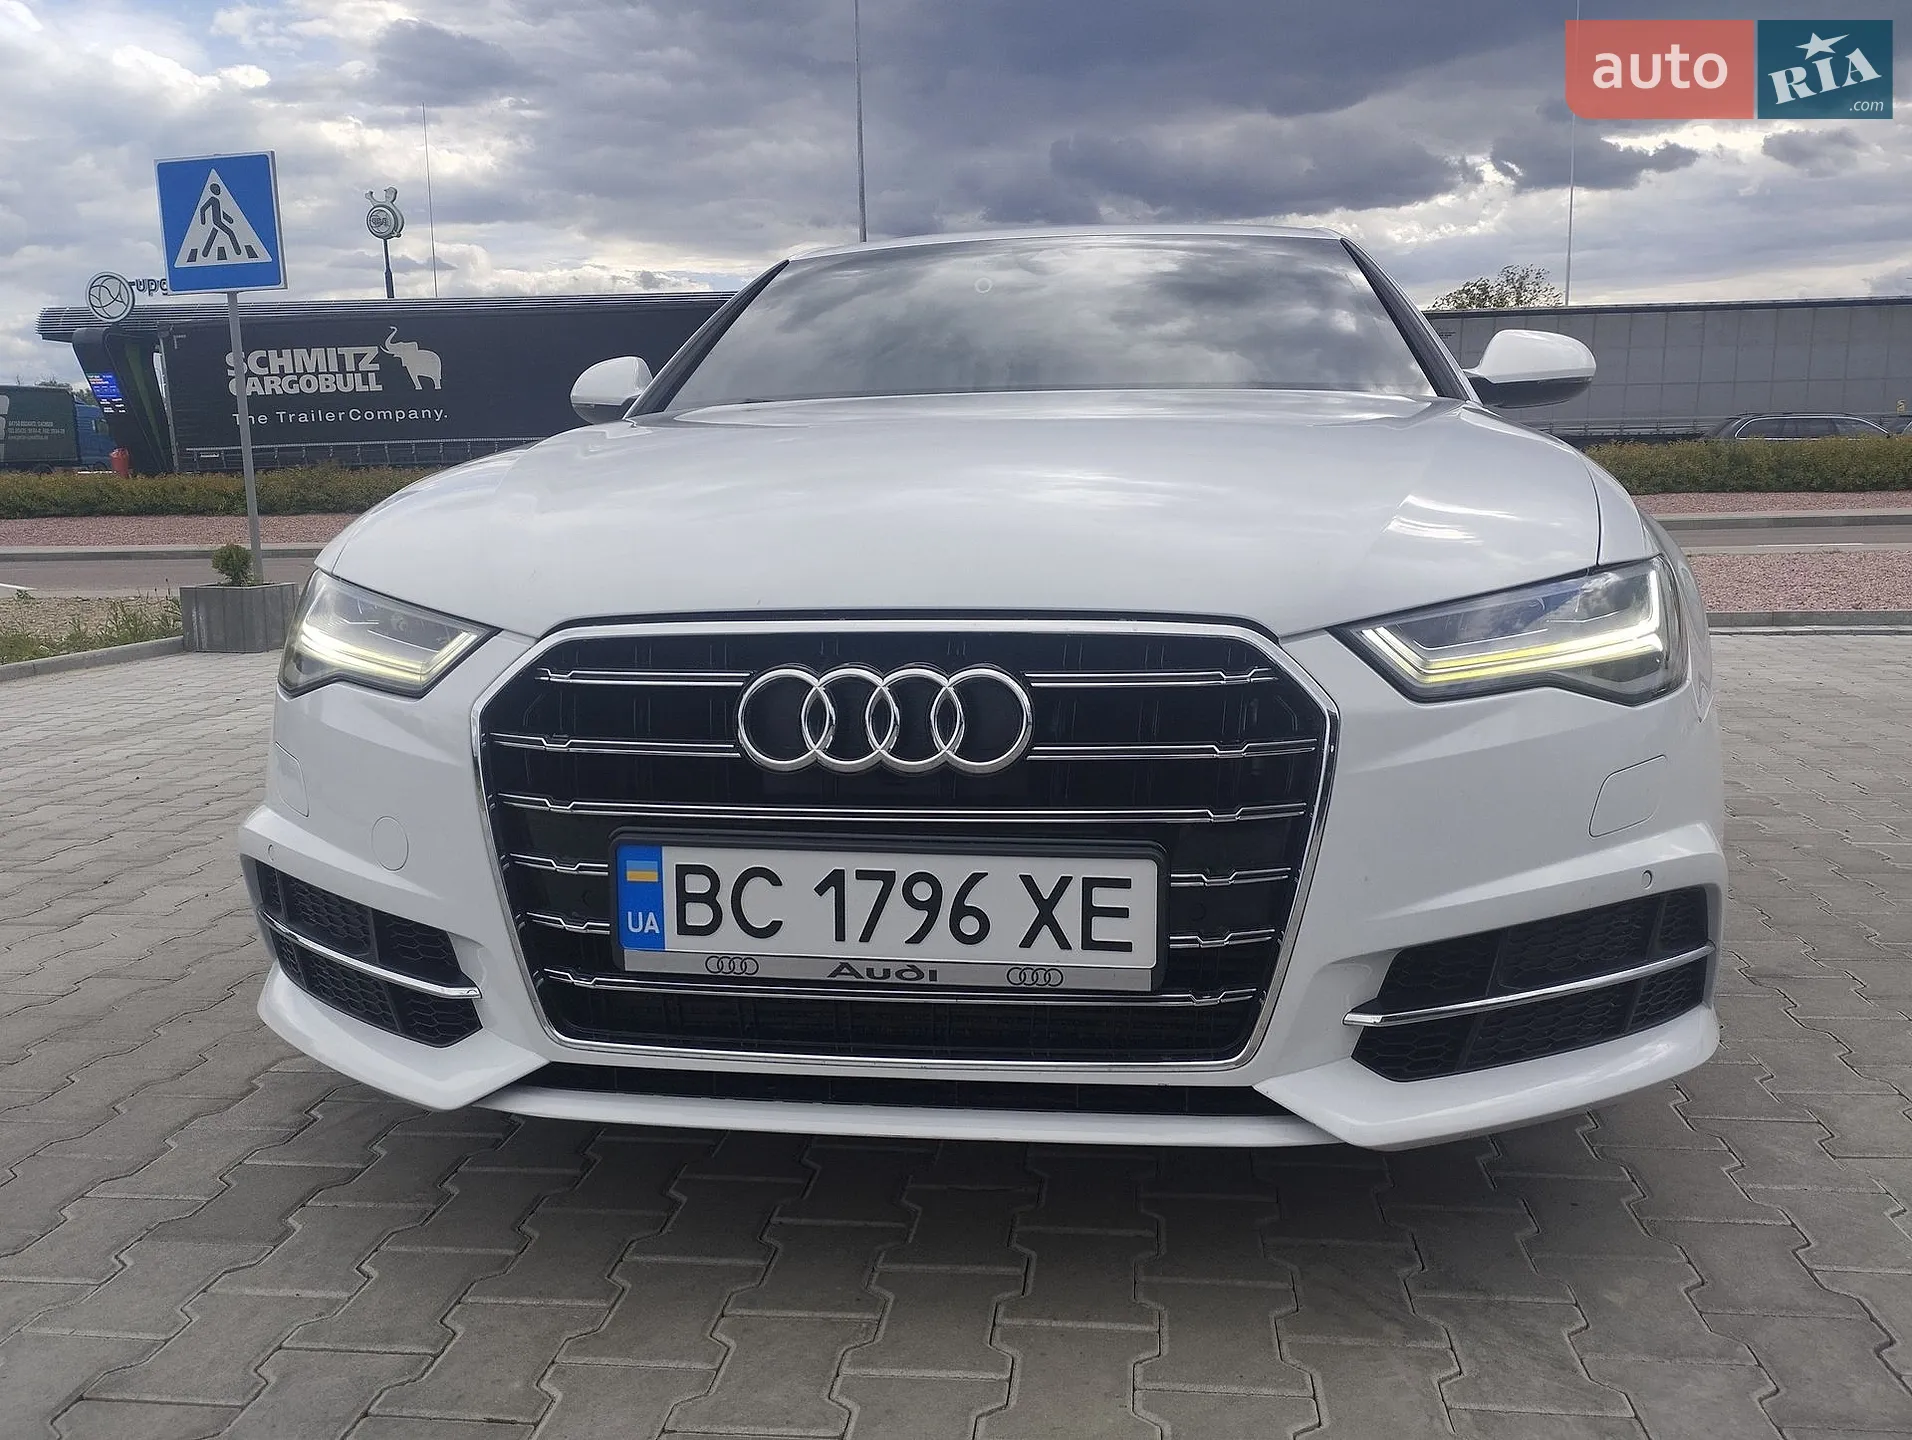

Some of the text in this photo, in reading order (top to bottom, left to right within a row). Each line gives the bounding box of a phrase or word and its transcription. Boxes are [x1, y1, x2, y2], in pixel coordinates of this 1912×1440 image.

[226, 346, 380, 376] SCHMITZ
[674, 863, 1133, 953] BC 1796 XE
[627, 911, 660, 934] UA
[826, 961, 938, 982] Audi
